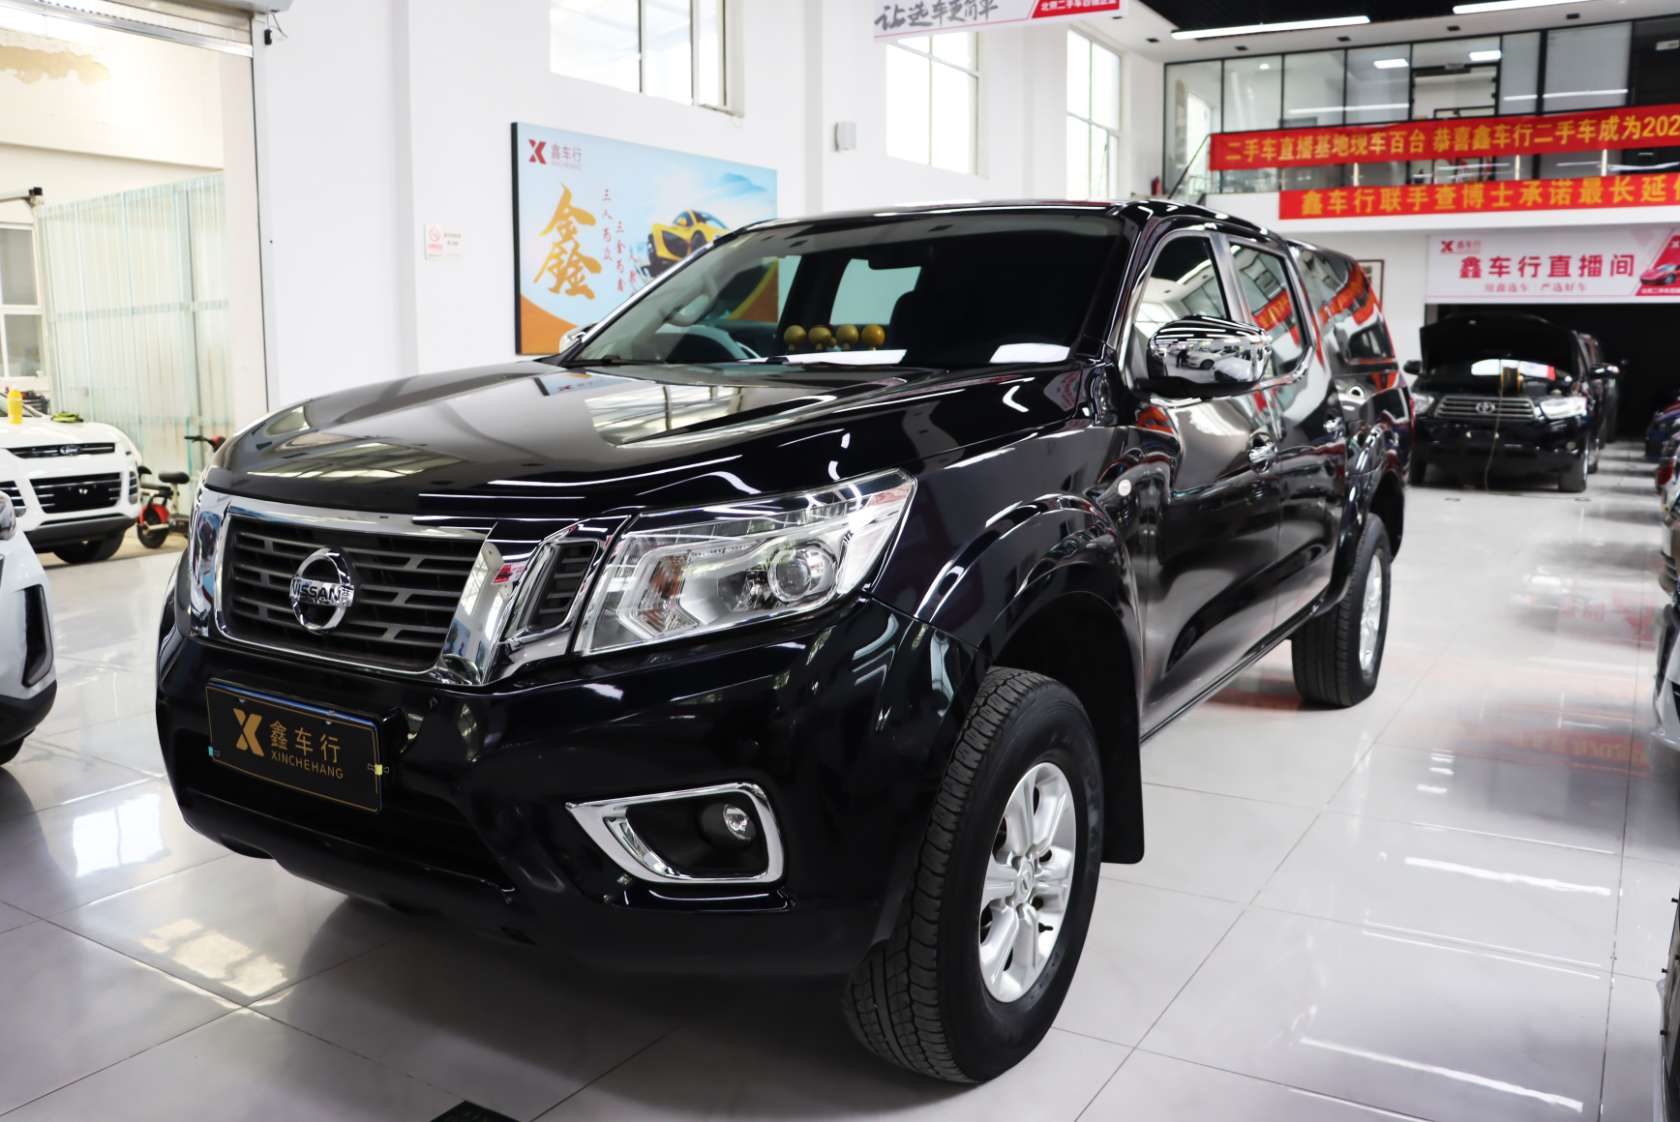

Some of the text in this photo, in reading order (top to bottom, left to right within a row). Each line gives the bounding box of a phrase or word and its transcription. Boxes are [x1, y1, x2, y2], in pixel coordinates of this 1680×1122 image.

[1460, 254, 1635, 279] 鑫车行直播间
[292, 579, 341, 601] NISSAN
[270, 720, 341, 764] 鑫车行
[271, 750, 344, 780] XINCHEHANG
